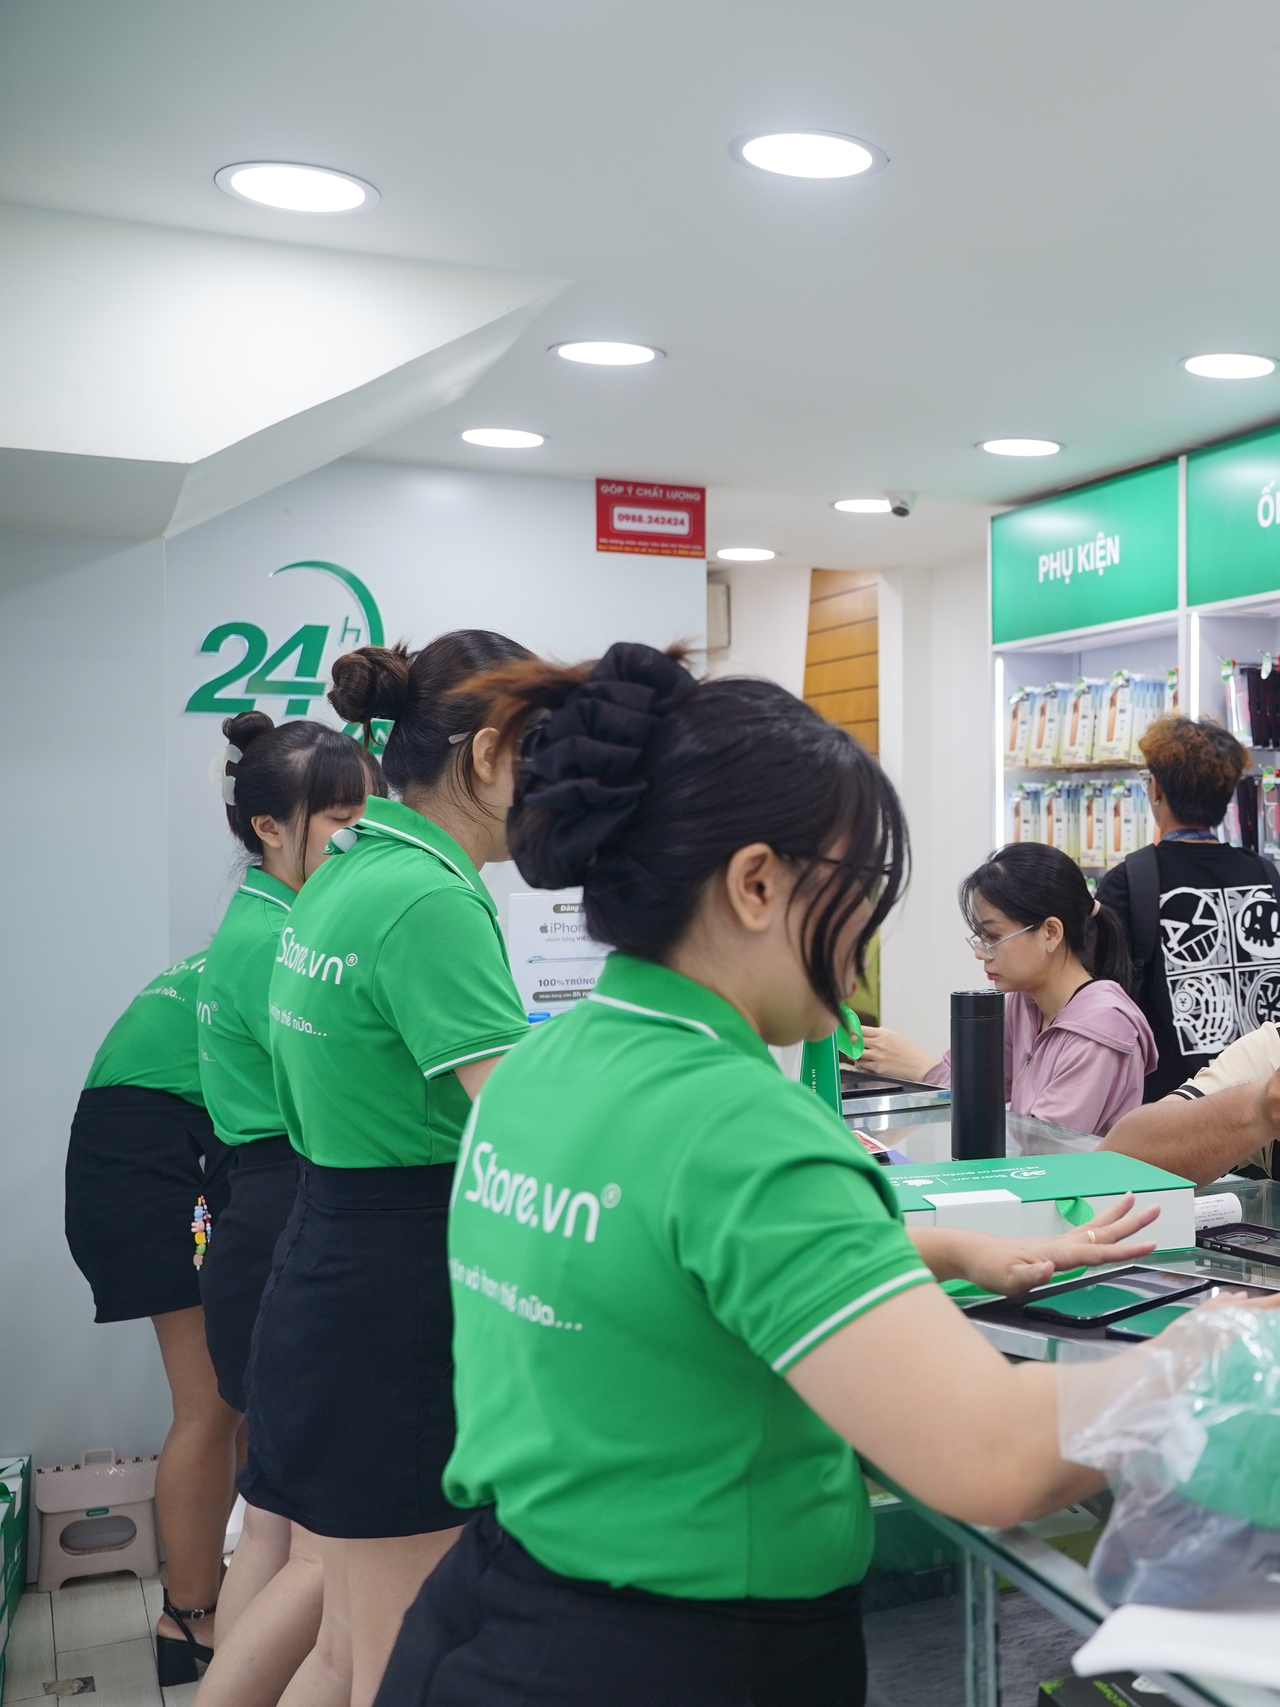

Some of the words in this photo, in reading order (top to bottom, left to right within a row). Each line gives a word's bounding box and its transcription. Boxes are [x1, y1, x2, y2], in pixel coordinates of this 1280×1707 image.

[601, 483, 625, 494] GÓP
[636, 486, 664, 499] CHẤT
[1038, 548, 1073, 584] PHỤ
[1077, 531, 1120, 576] KIỆN
[185, 622, 330, 717] 24
[560, 904, 579, 913] Đăng
[550, 922, 587, 934] iPhon
[538, 979, 565, 987] 100%
[565, 977, 596, 986] TRÚNG
